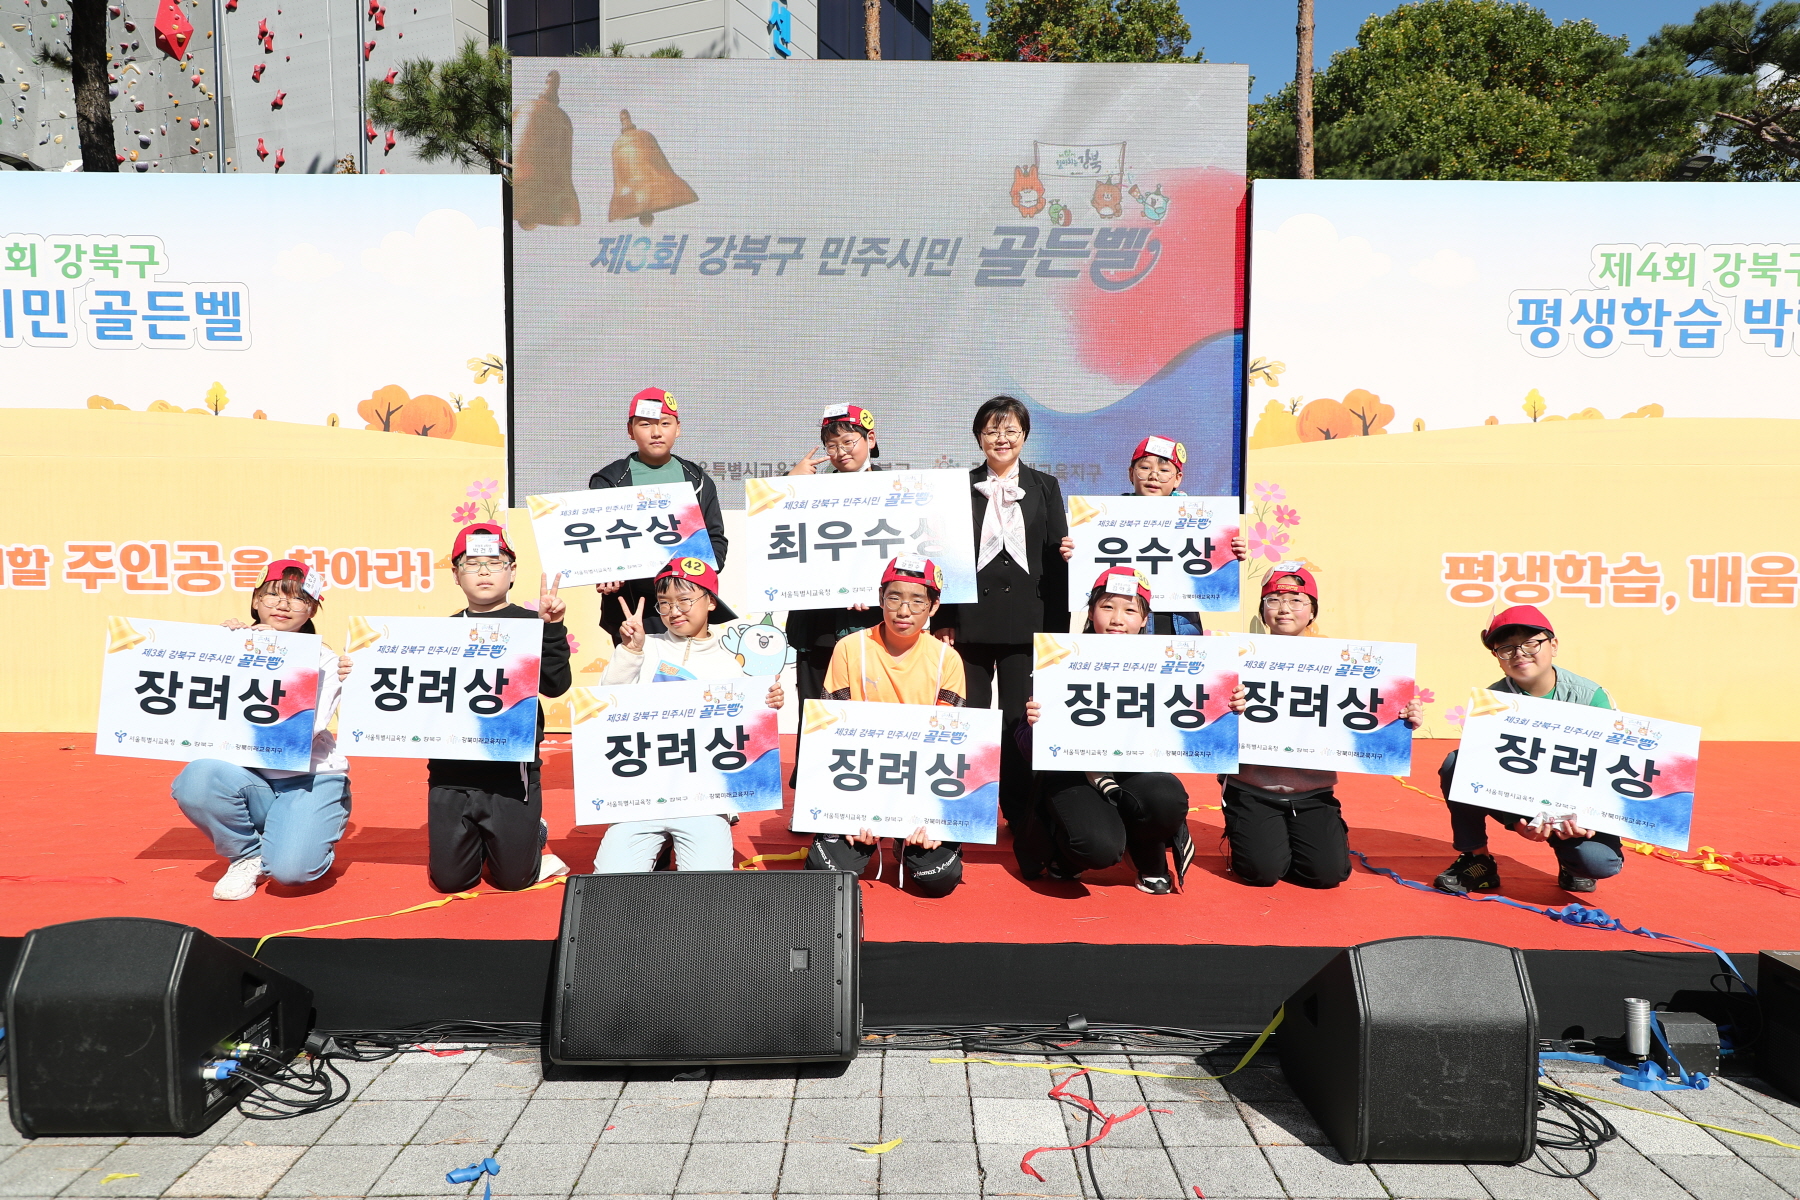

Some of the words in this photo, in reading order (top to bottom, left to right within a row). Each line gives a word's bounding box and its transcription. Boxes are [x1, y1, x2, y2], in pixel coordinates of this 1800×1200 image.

[1078, 149, 1101, 173] 강북
[54, 244, 159, 279] 강북구
[590, 234, 689, 275] 제3회
[699, 235, 806, 275] 강북구
[818, 236, 963, 277] 민주시민
[975, 226, 1161, 291] 골든벨
[1598, 252, 1696, 287] 제4회
[89, 290, 243, 341] 골든벨
[1517, 297, 1722, 349] 평생학습
[1744, 298, 1800, 348] 박
[862, 412, 874, 426] 27
[560, 509, 578, 517] 제3회
[605, 504, 633, 512] 민주시민
[637, 500, 671, 511] 골든벨
[784, 500, 807, 510] 제3회
[812, 499, 839, 509] 강북구
[844, 497, 880, 507] 민주시민
[885, 492, 934, 507] 골든벨
[564, 514, 682, 553] 우수상
[1175, 518, 1211, 529] 골든벨
[0, 548, 49, 587] 할
[684, 560, 702, 571] 42
[1095, 537, 1215, 575] 우수상
[1445, 554, 1677, 611] 평생학습,
[1690, 555, 1798, 603] 배움
[142, 648, 165, 657] 제3회
[168, 651, 196, 660] 강북구
[199, 654, 235, 664] 민주시민
[237, 654, 284, 670] 골든벨
[377, 645, 399, 653] 제3회
[401, 646, 425, 654] 강북구
[428, 646, 461, 655] 민주시민
[463, 644, 507, 658] 골든벨
[1068, 662, 1091, 670] 제3회
[1094, 662, 1119, 671] 강북구
[1122, 662, 1157, 672] 민주시민
[1160, 661, 1205, 675] 골든벨
[1244, 660, 1267, 669] 제3회
[1269, 662, 1294, 671] 강북구
[1297, 663, 1332, 674] 민주시민
[1335, 664, 1380, 678] 골든벨
[135, 670, 286, 724] 장려상
[371, 666, 509, 714] 장려상
[1065, 682, 1209, 728] 장려상
[1242, 681, 1384, 730] 장려상
[607, 714, 629, 722] 제3회
[633, 712, 658, 721] 강북구
[662, 709, 696, 719] 민주시민
[700, 703, 743, 718] 골든벨
[835, 728, 857, 736] 제3회
[859, 729, 884, 738] 강북구
[887, 731, 921, 740] 민주시민
[923, 730, 967, 745] 골든벨
[1504, 716, 1529, 726] 제3회
[1532, 720, 1561, 731] 강북구
[1564, 726, 1603, 739] 민주시민
[1605, 733, 1658, 750] 골든벨
[605, 725, 750, 777] 장려상
[1495, 733, 1660, 798] 장려상
[828, 749, 970, 797] 장려상
